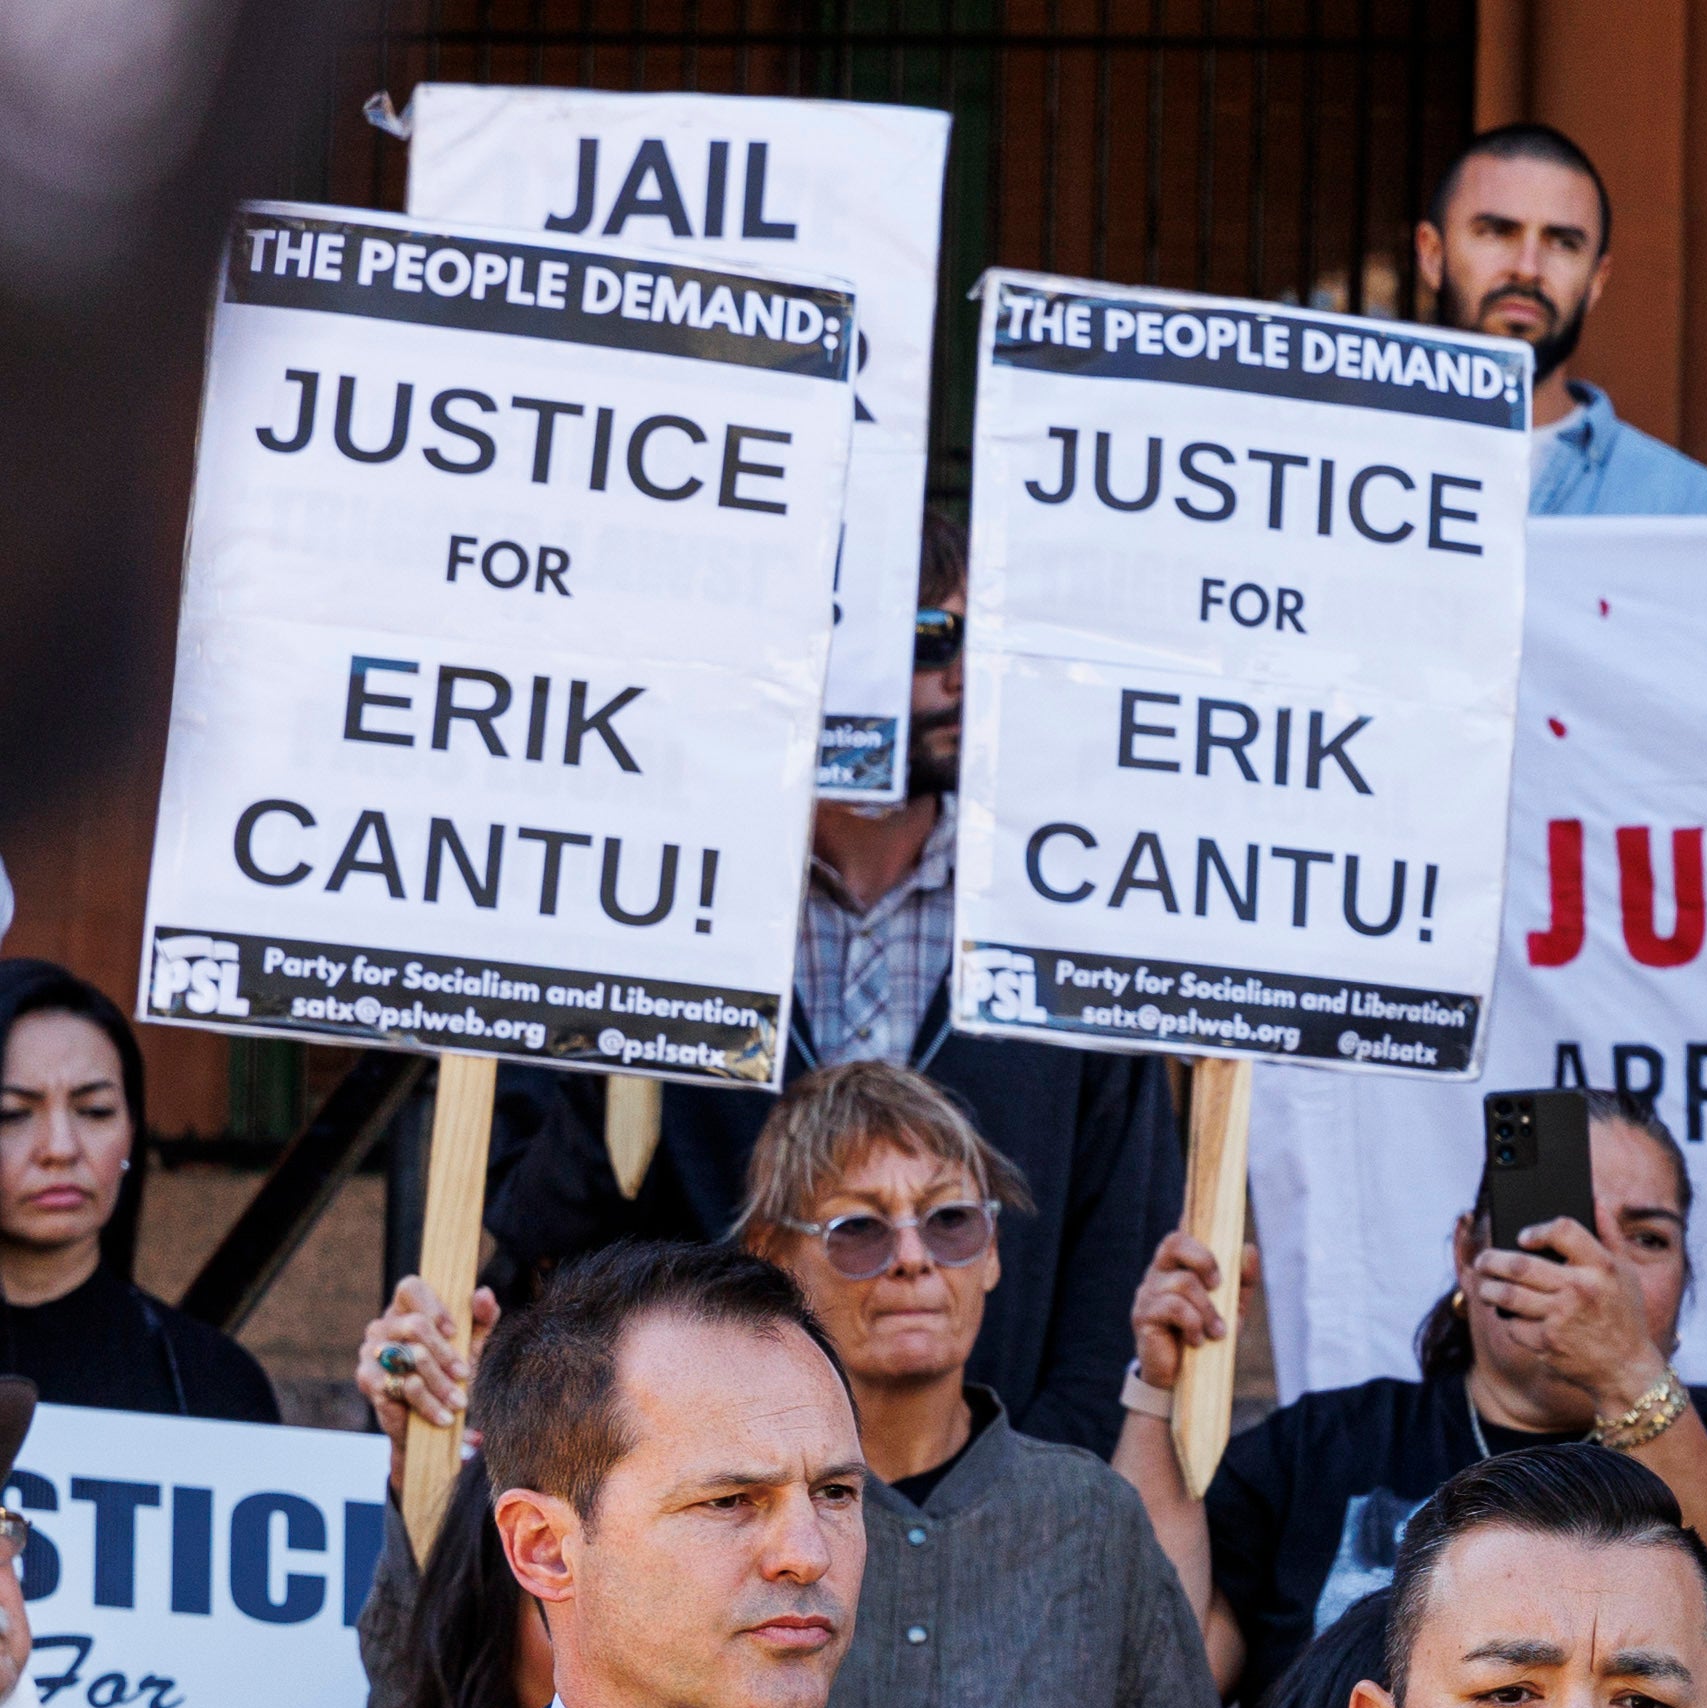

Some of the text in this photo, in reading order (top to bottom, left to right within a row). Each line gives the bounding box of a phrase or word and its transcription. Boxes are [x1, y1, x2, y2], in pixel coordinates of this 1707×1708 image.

[545, 138, 798, 241] JAIL
[247, 229, 841, 351] THE PEOPLE DEMAND:
[1005, 297, 1520, 404] THE PEOPLE DEMAND:
[255, 367, 794, 516] JUSTICE
[1025, 427, 1484, 556] JUSTICE
[446, 535, 573, 597] FOR
[1200, 576, 1308, 634] FOR
[342, 654, 648, 774] ERIK
[1117, 688, 1374, 795] ERIK
[231, 798, 721, 935] CANTU!
[1025, 822, 1440, 944] CANTU!
[153, 953, 249, 1018] PSL
[262, 947, 760, 1029] Party for Socialism and Liberation
[290, 994, 726, 1070] satx@pslweb.org @pslsatx
[964, 966, 1047, 1025] PSL
[1055, 960, 1467, 1029] Party for Socialism and Liberation
[1081, 1003, 1439, 1067] satx@pslweb.org @pslsatx
